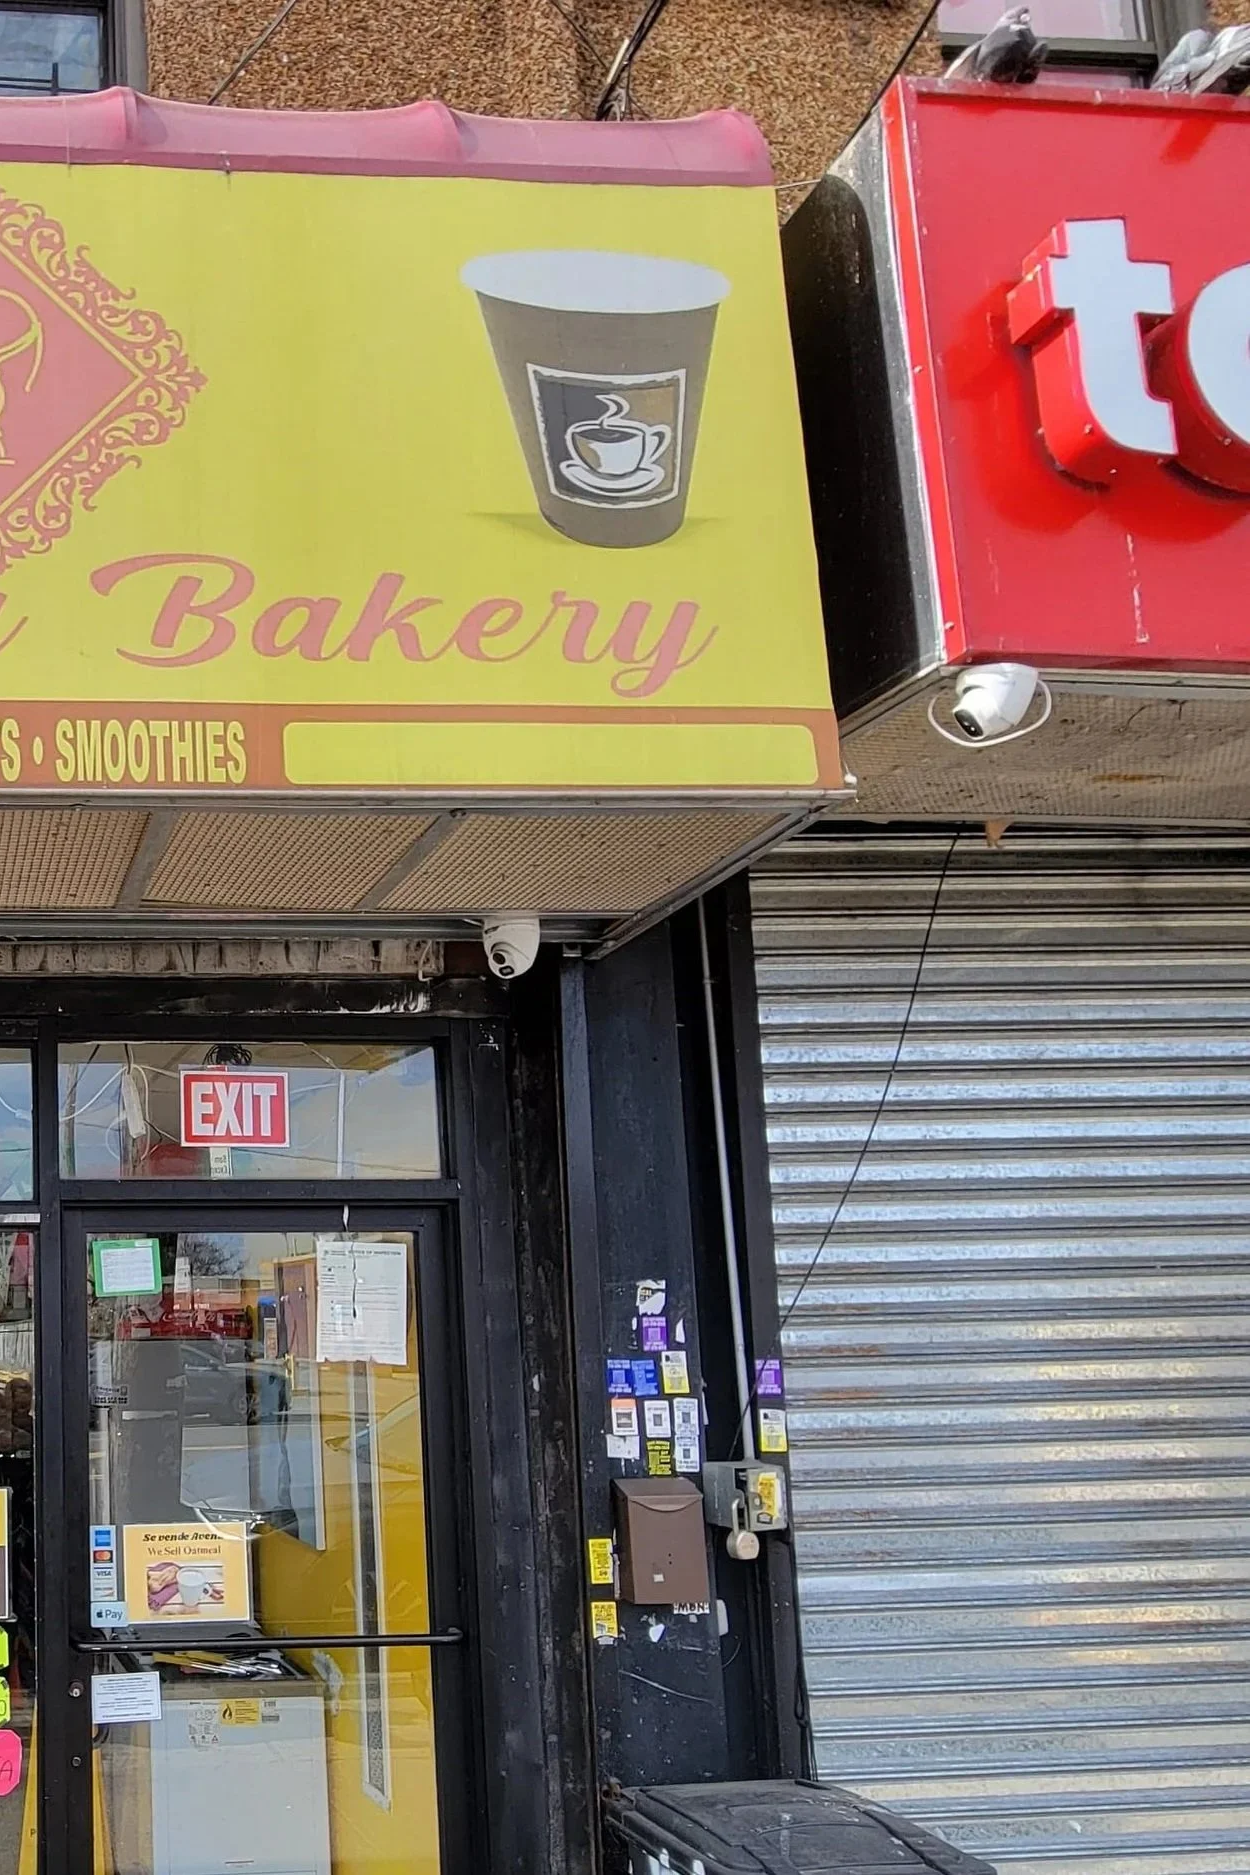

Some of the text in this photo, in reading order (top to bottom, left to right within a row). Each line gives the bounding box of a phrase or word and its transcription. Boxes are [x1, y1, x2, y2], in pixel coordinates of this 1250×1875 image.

[89, 553, 719, 699] Bakery
[54, 719, 248, 785] SMOOTHIES
[190, 1081, 277, 1137] EXIT
[143, 1533, 156, 1541] Se
[158, 1532, 189, 1541] vende
[164, 1546, 181, 1555] Sell
[184, 1545, 221, 1554] Oatmeal
[105, 1610, 123, 1621] Pay
